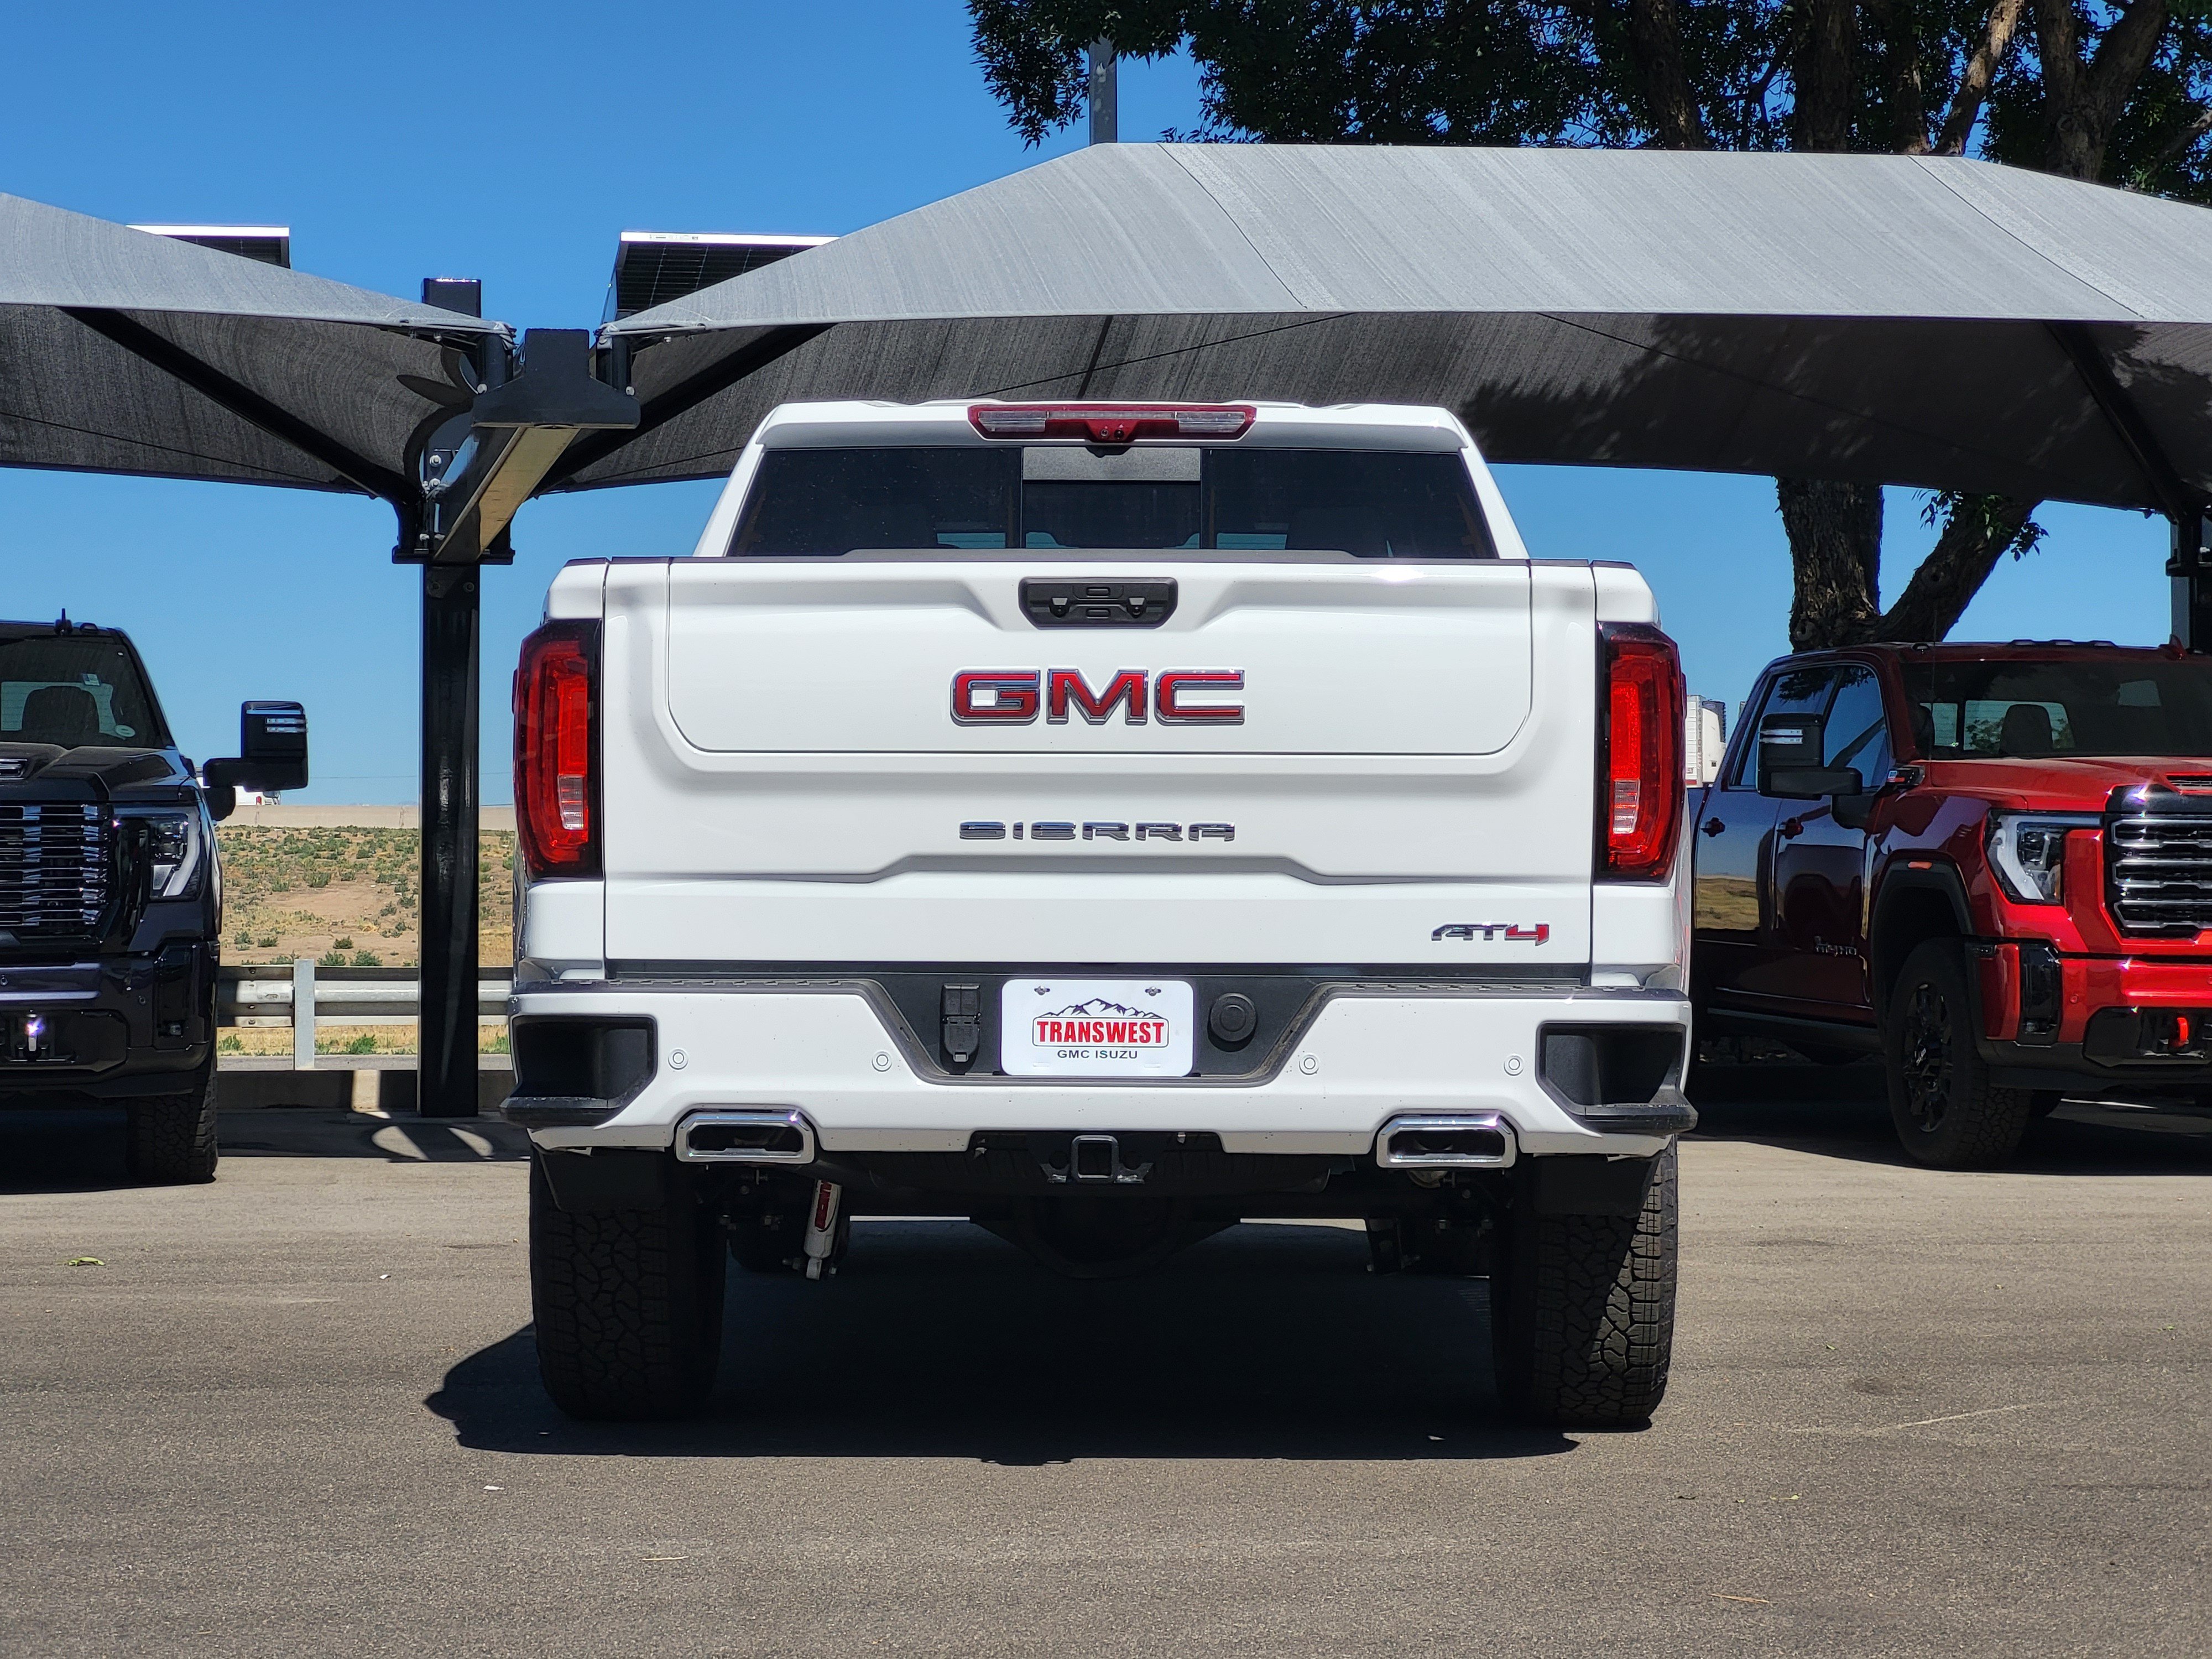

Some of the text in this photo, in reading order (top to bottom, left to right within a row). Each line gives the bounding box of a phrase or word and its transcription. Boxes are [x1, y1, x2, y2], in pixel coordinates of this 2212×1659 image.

[950, 667, 1245, 726] GMC
[959, 821, 1235, 842] SIERRA
[1431, 924, 1550, 946] AT4
[1037, 1020, 1164, 1044] TRANSWEST
[1057, 1050, 1138, 1058] GMC ISUZU
